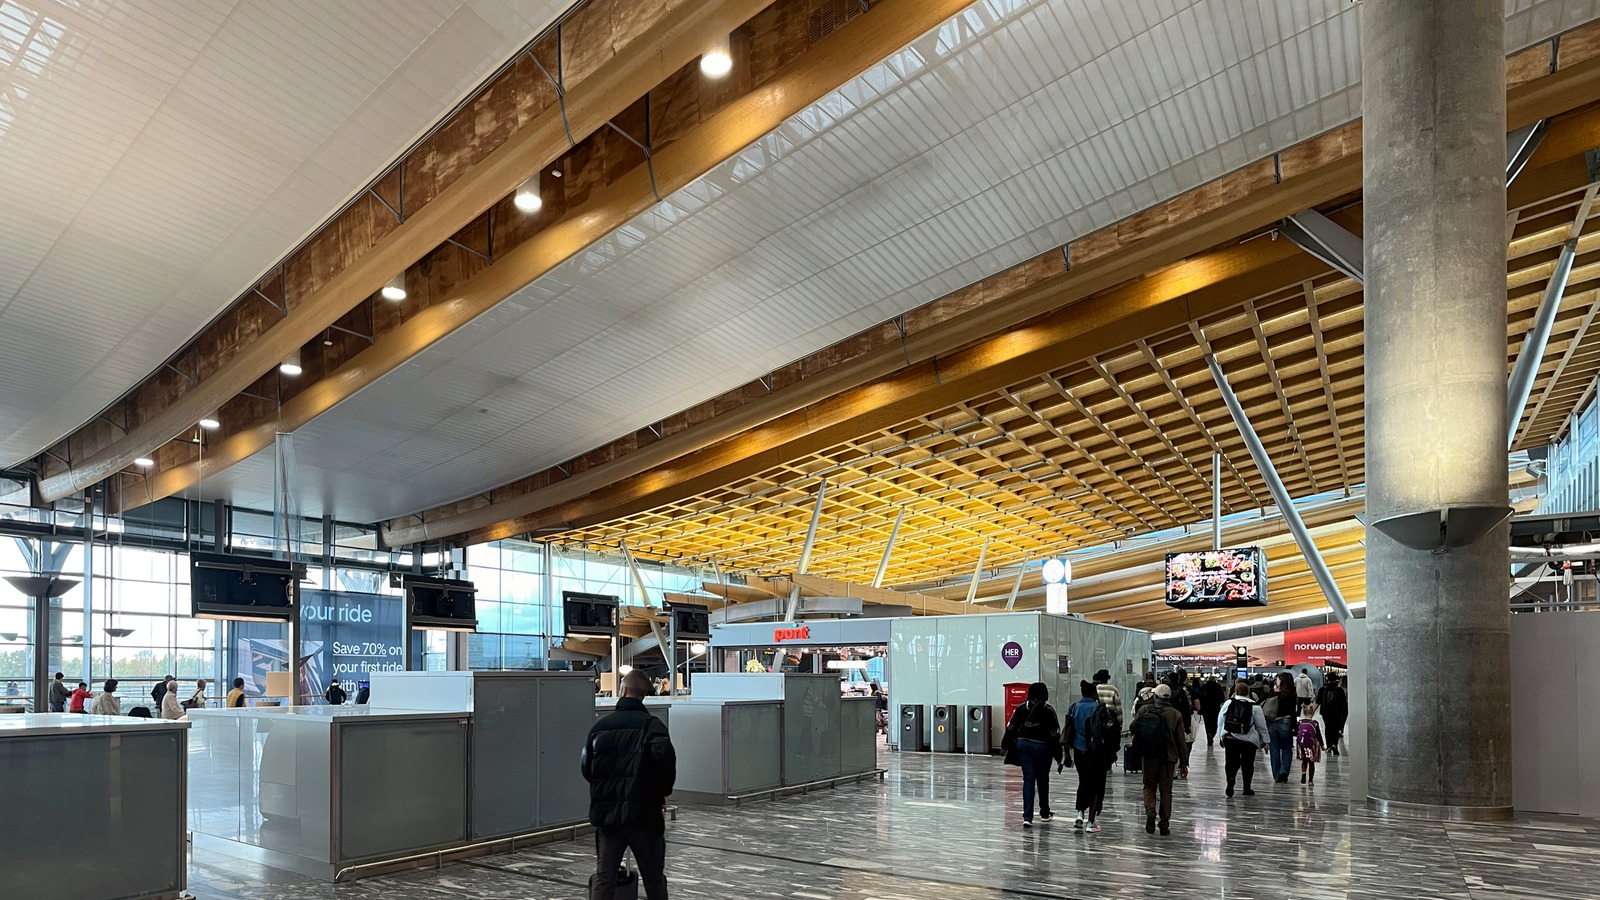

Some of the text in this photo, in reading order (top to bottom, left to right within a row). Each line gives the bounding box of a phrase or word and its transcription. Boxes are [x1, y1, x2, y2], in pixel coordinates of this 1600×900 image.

[339, 604, 372, 622] ride
[333, 642, 403, 656] Save 70% on
[1294, 642, 1346, 651] norwegian
[333, 661, 403, 676] your first ride
